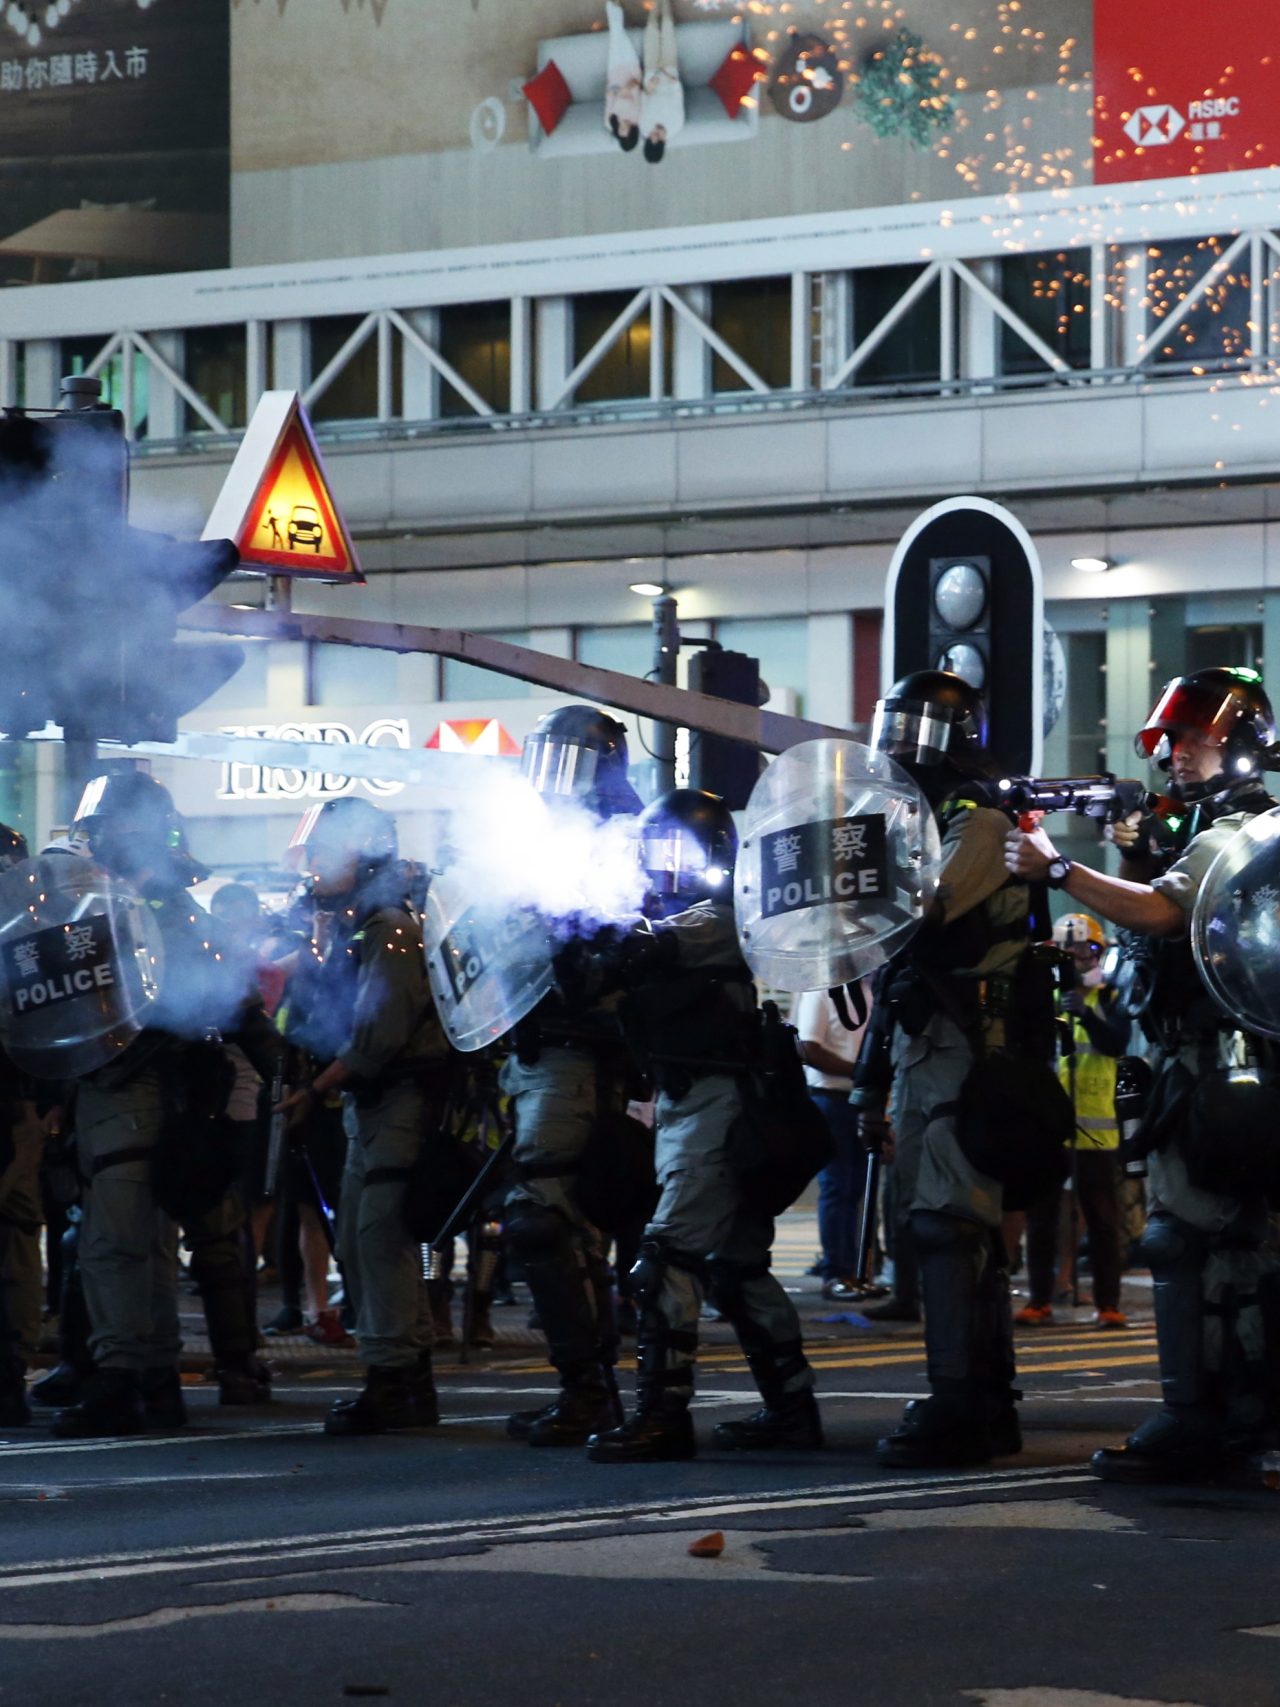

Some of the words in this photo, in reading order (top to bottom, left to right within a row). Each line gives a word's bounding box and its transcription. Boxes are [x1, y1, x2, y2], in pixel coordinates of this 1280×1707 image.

[1188, 97, 1240, 120] HSBC
[773, 822, 868, 875] 警察
[767, 868, 879, 912] POLICE
[13, 925, 97, 977] 警察
[15, 962, 114, 1011] POLICE
